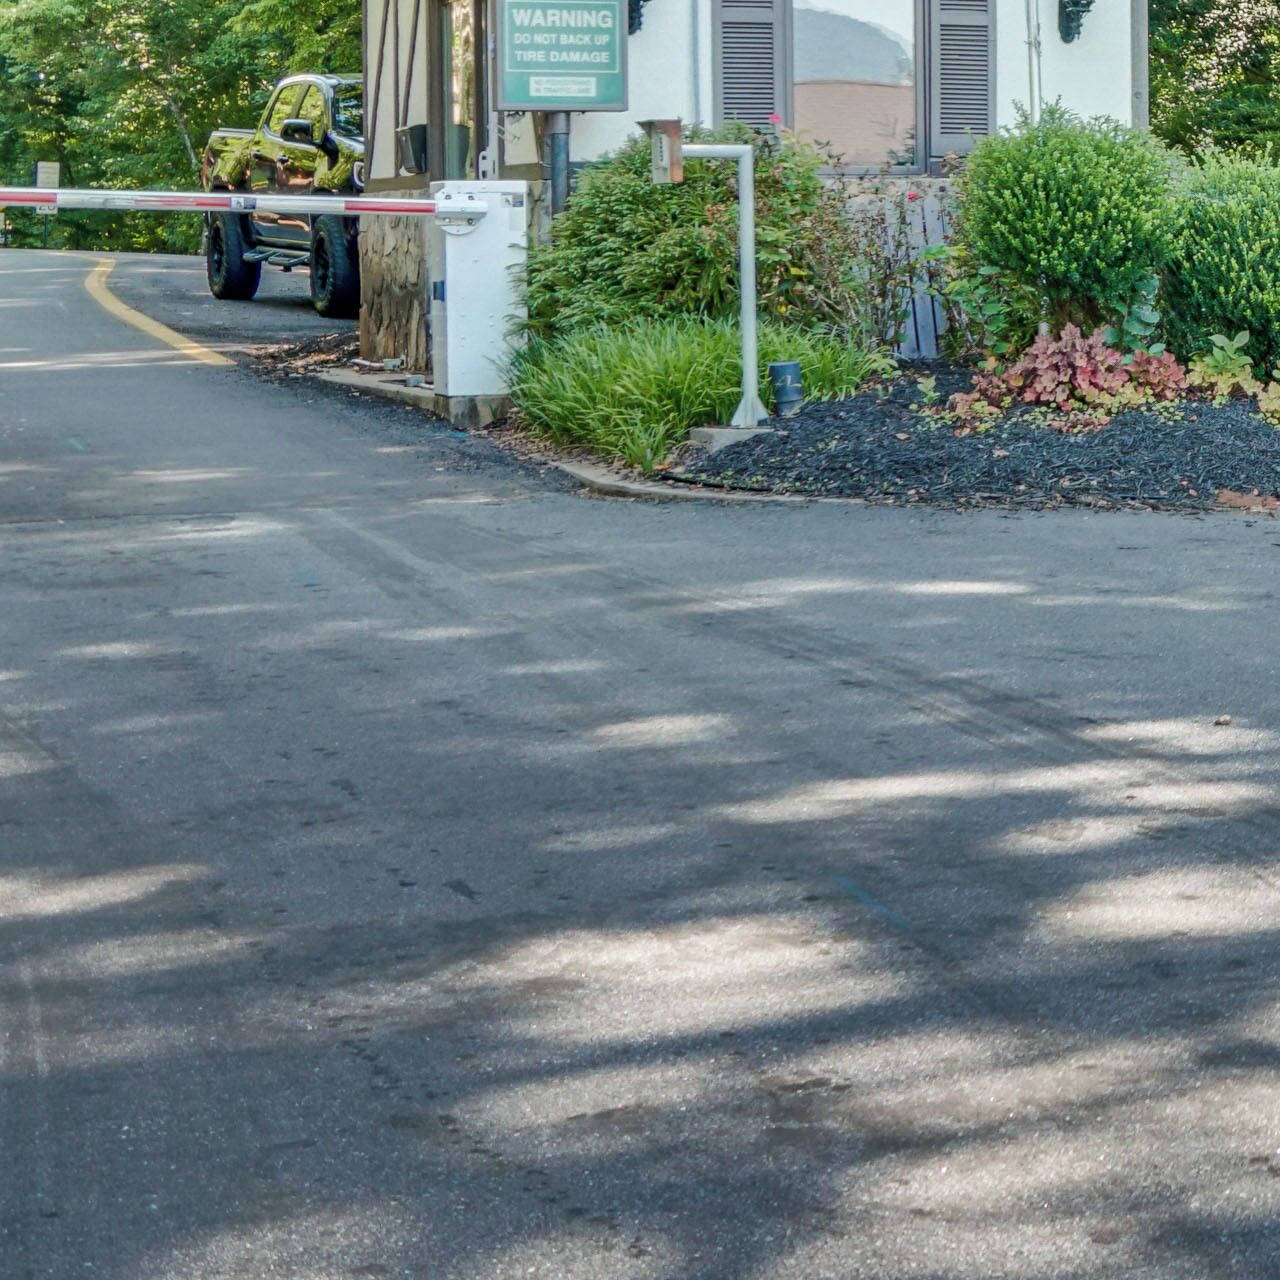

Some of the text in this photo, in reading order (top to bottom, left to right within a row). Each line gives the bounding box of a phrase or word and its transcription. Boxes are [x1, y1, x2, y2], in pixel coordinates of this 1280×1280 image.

[512, 8, 613, 28] WARNING
[514, 33, 610, 46] DO NOT BACK UP
[514, 50, 610, 63] TIRE DAMAGE
